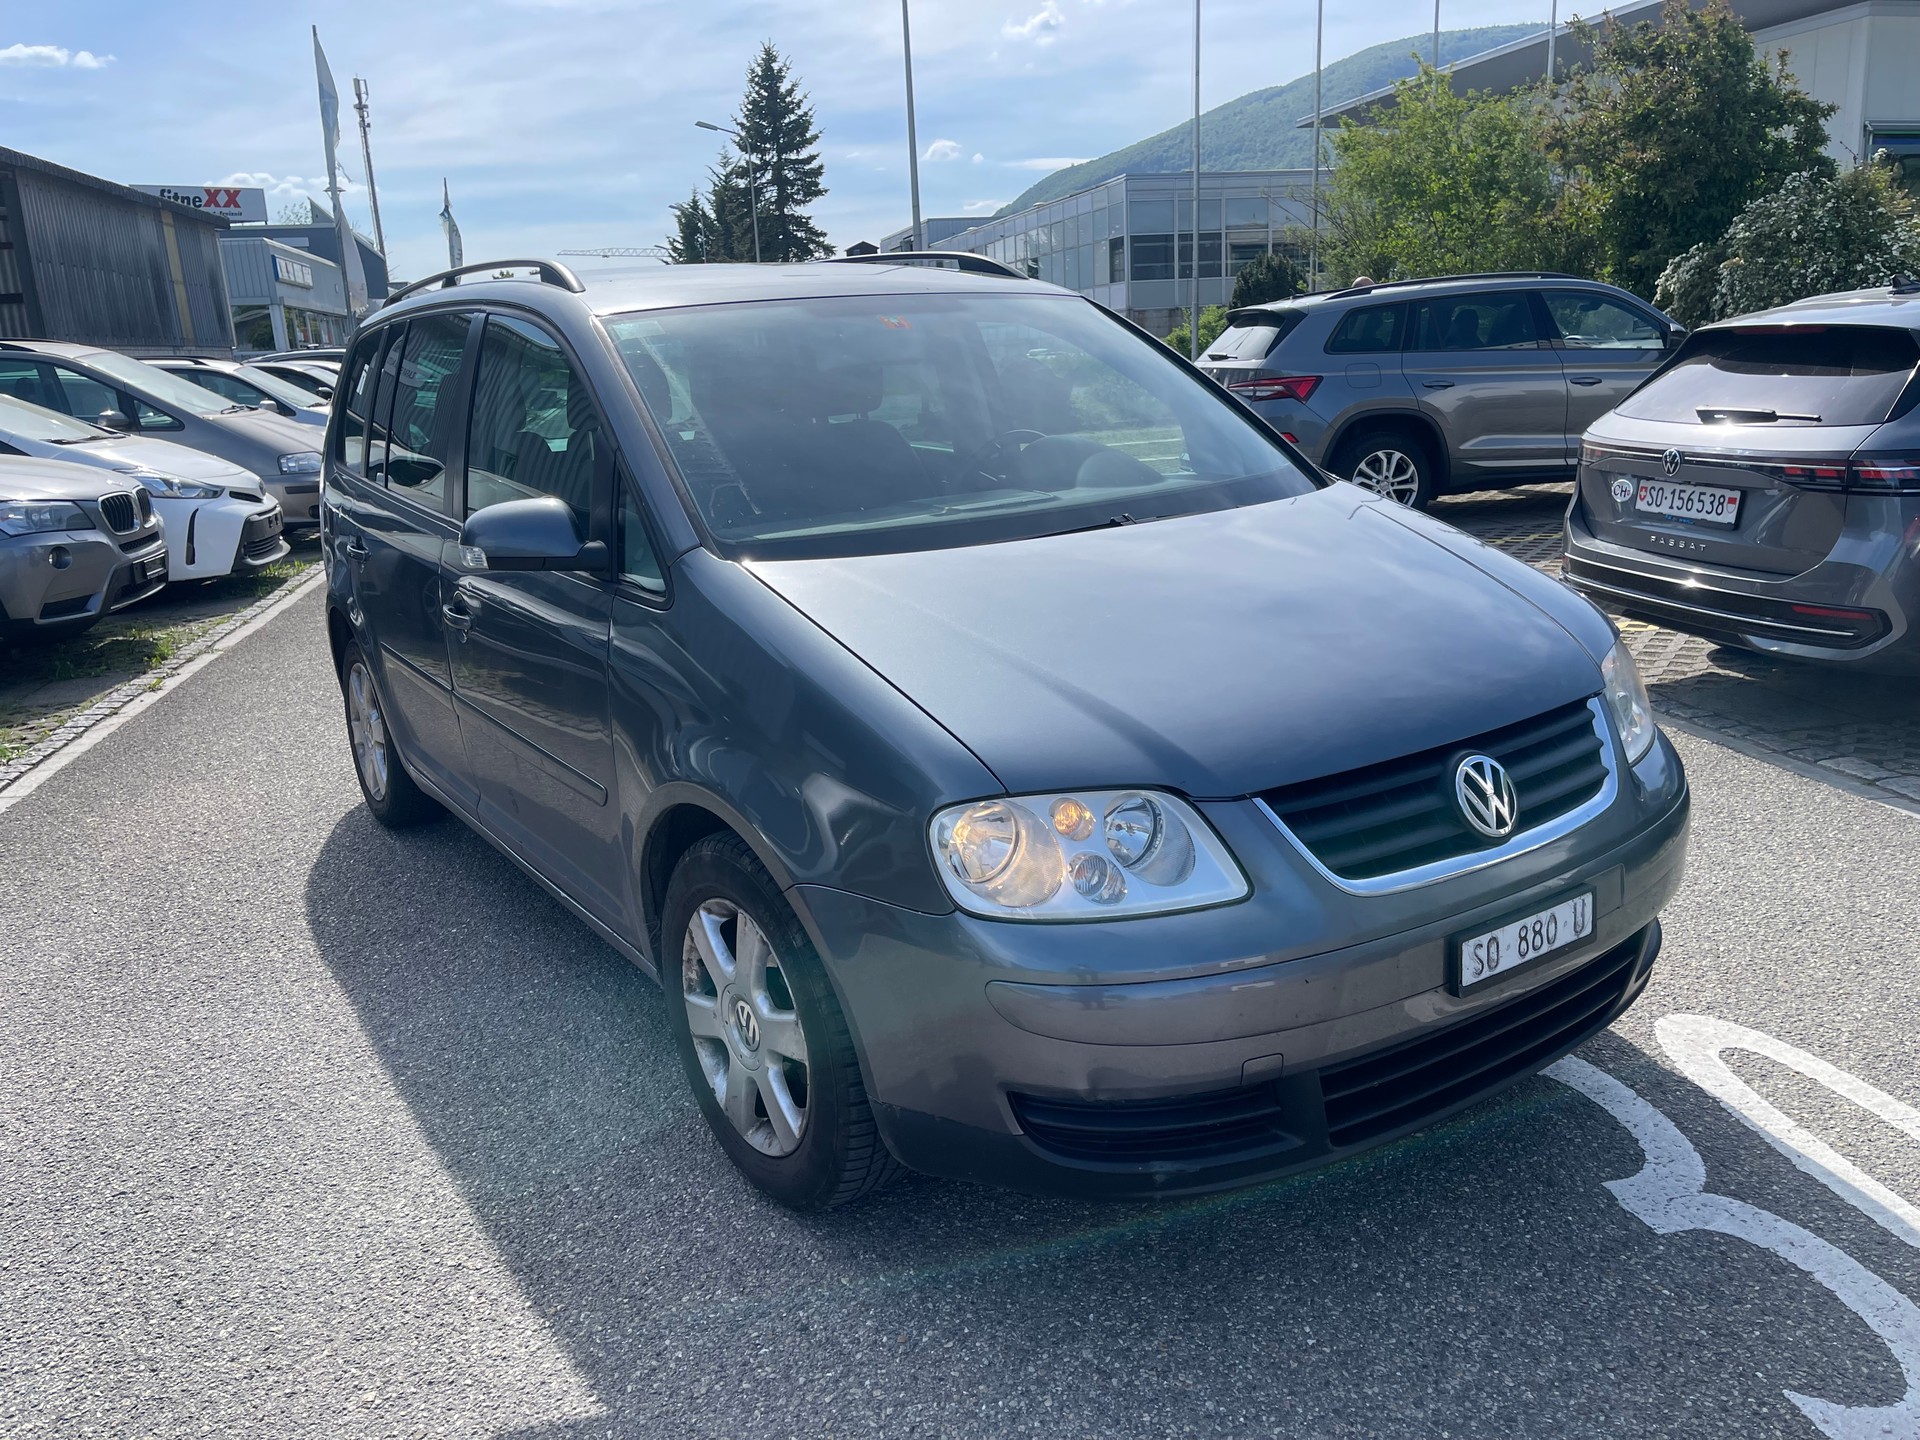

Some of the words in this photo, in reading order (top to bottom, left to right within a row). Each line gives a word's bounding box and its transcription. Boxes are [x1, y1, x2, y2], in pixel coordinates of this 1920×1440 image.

[1613, 484, 1628, 498] CH
[1649, 535, 1707, 552] PASSAT
[1471, 934, 1500, 978] SO
[1517, 912, 1558, 960] 880
[1572, 898, 1586, 937] U
